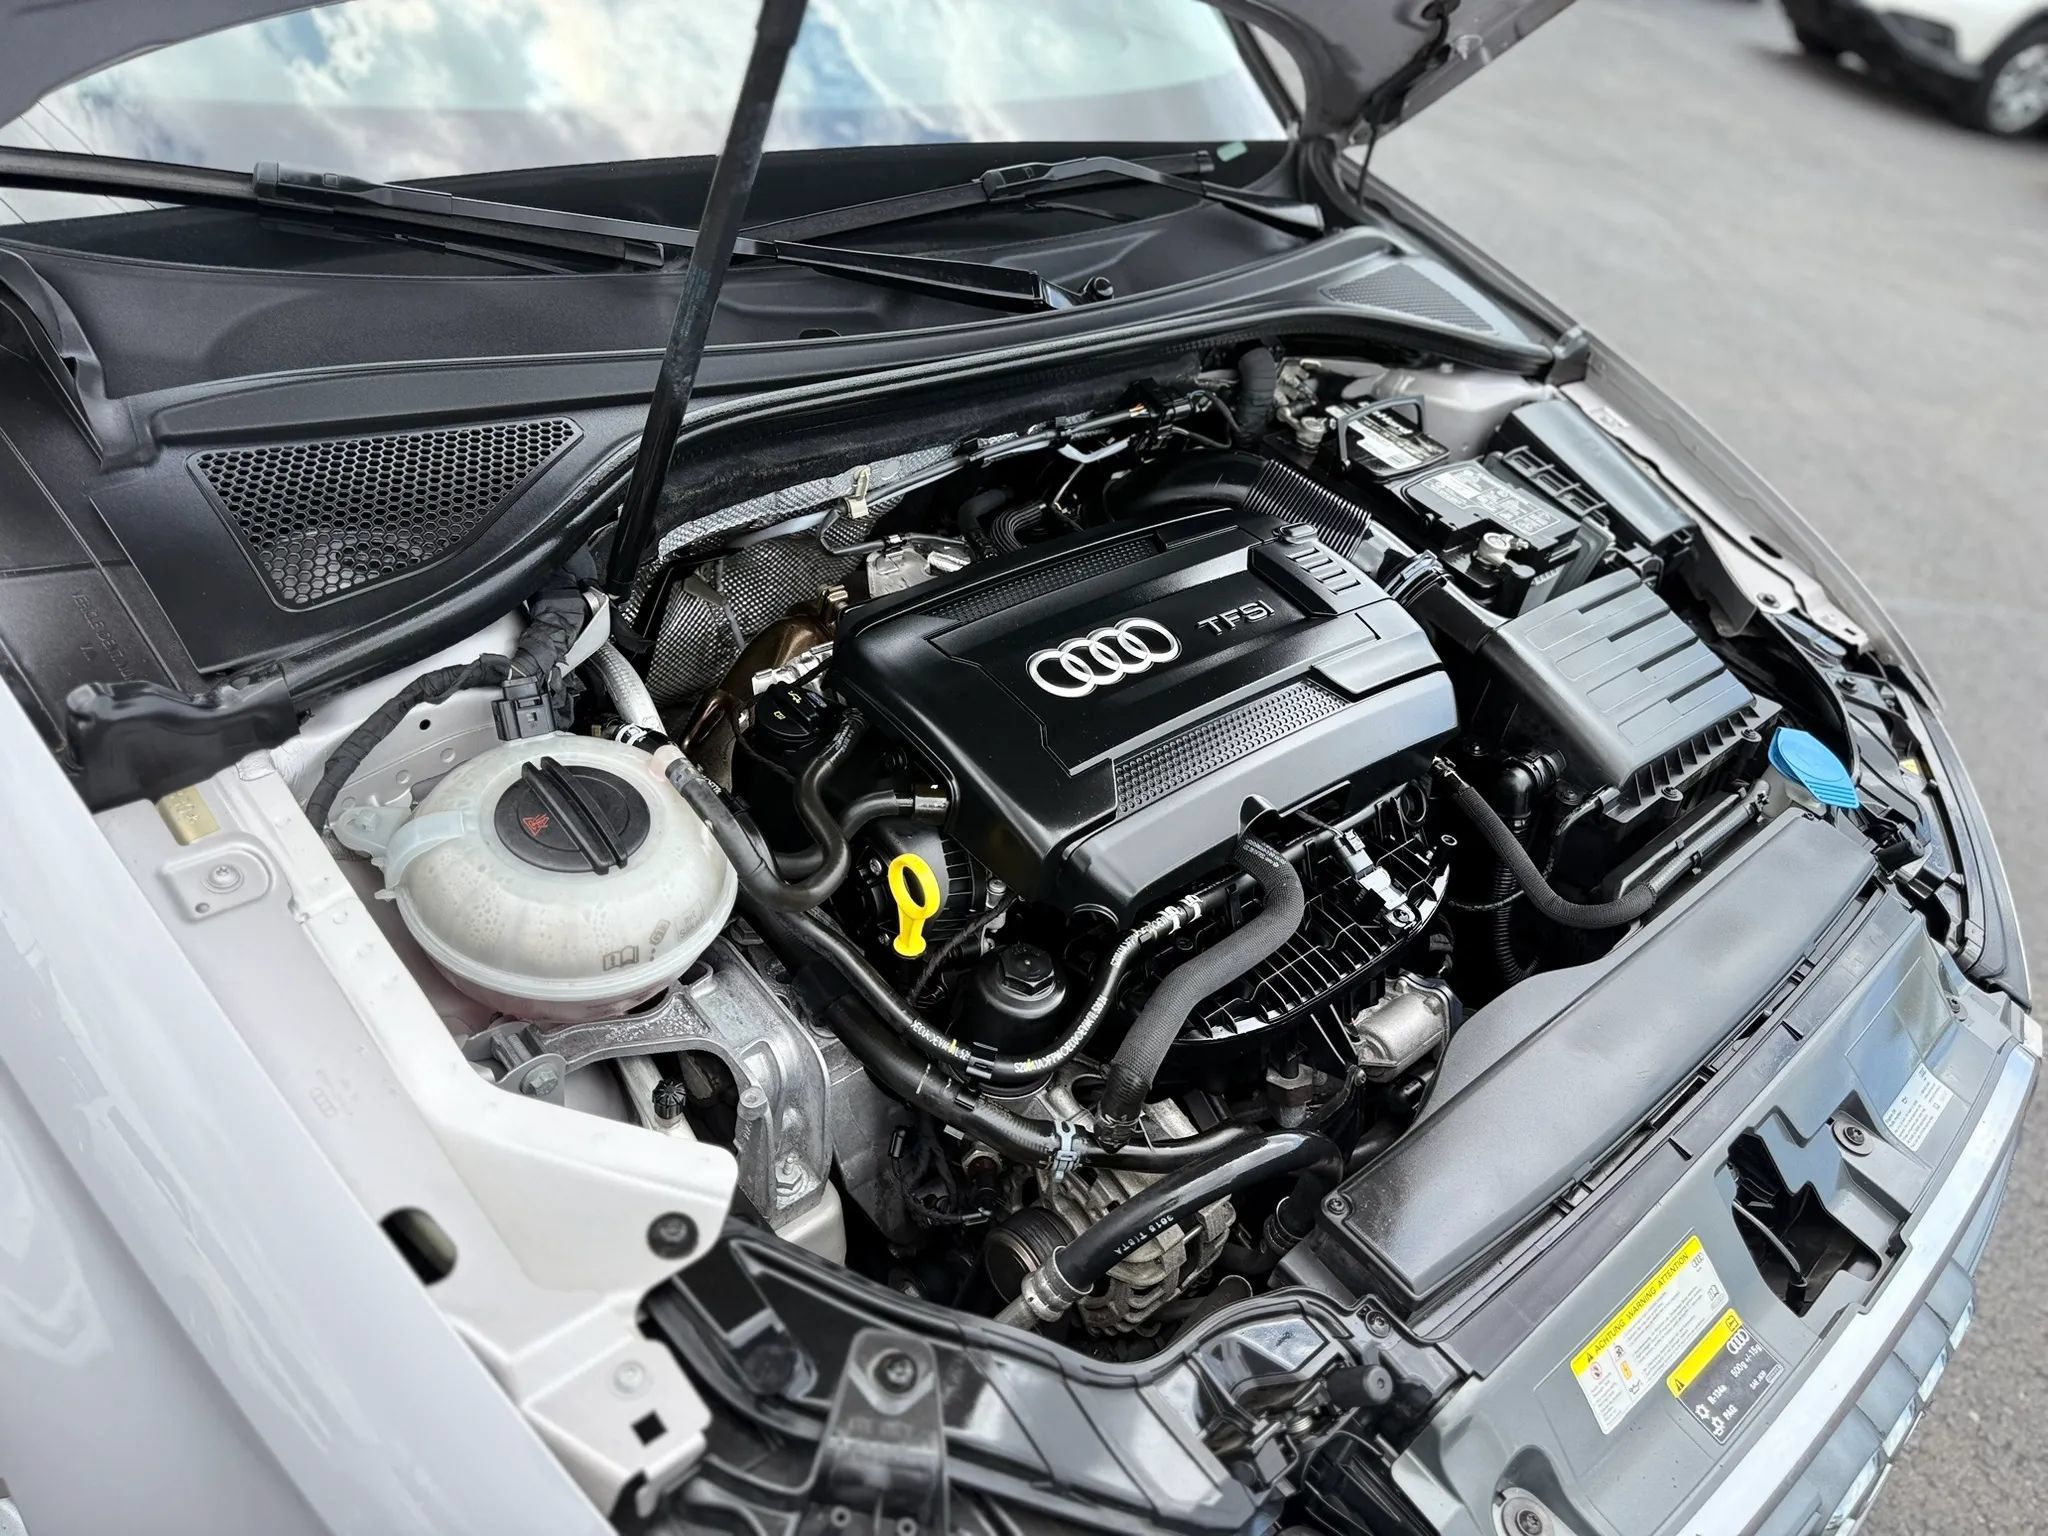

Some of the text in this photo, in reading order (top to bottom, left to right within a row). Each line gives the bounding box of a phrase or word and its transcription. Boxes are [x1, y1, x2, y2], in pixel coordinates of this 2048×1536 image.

[1358, 401, 1413, 434] DeHard
[1195, 600, 1275, 636] TFSI
[1594, 1320, 1625, 1353] ACHTUNG
[1626, 1287, 1657, 1320] WARNING
[1657, 1252, 1689, 1288] ATTENTION
[1722, 1405, 1738, 1421] PAG
